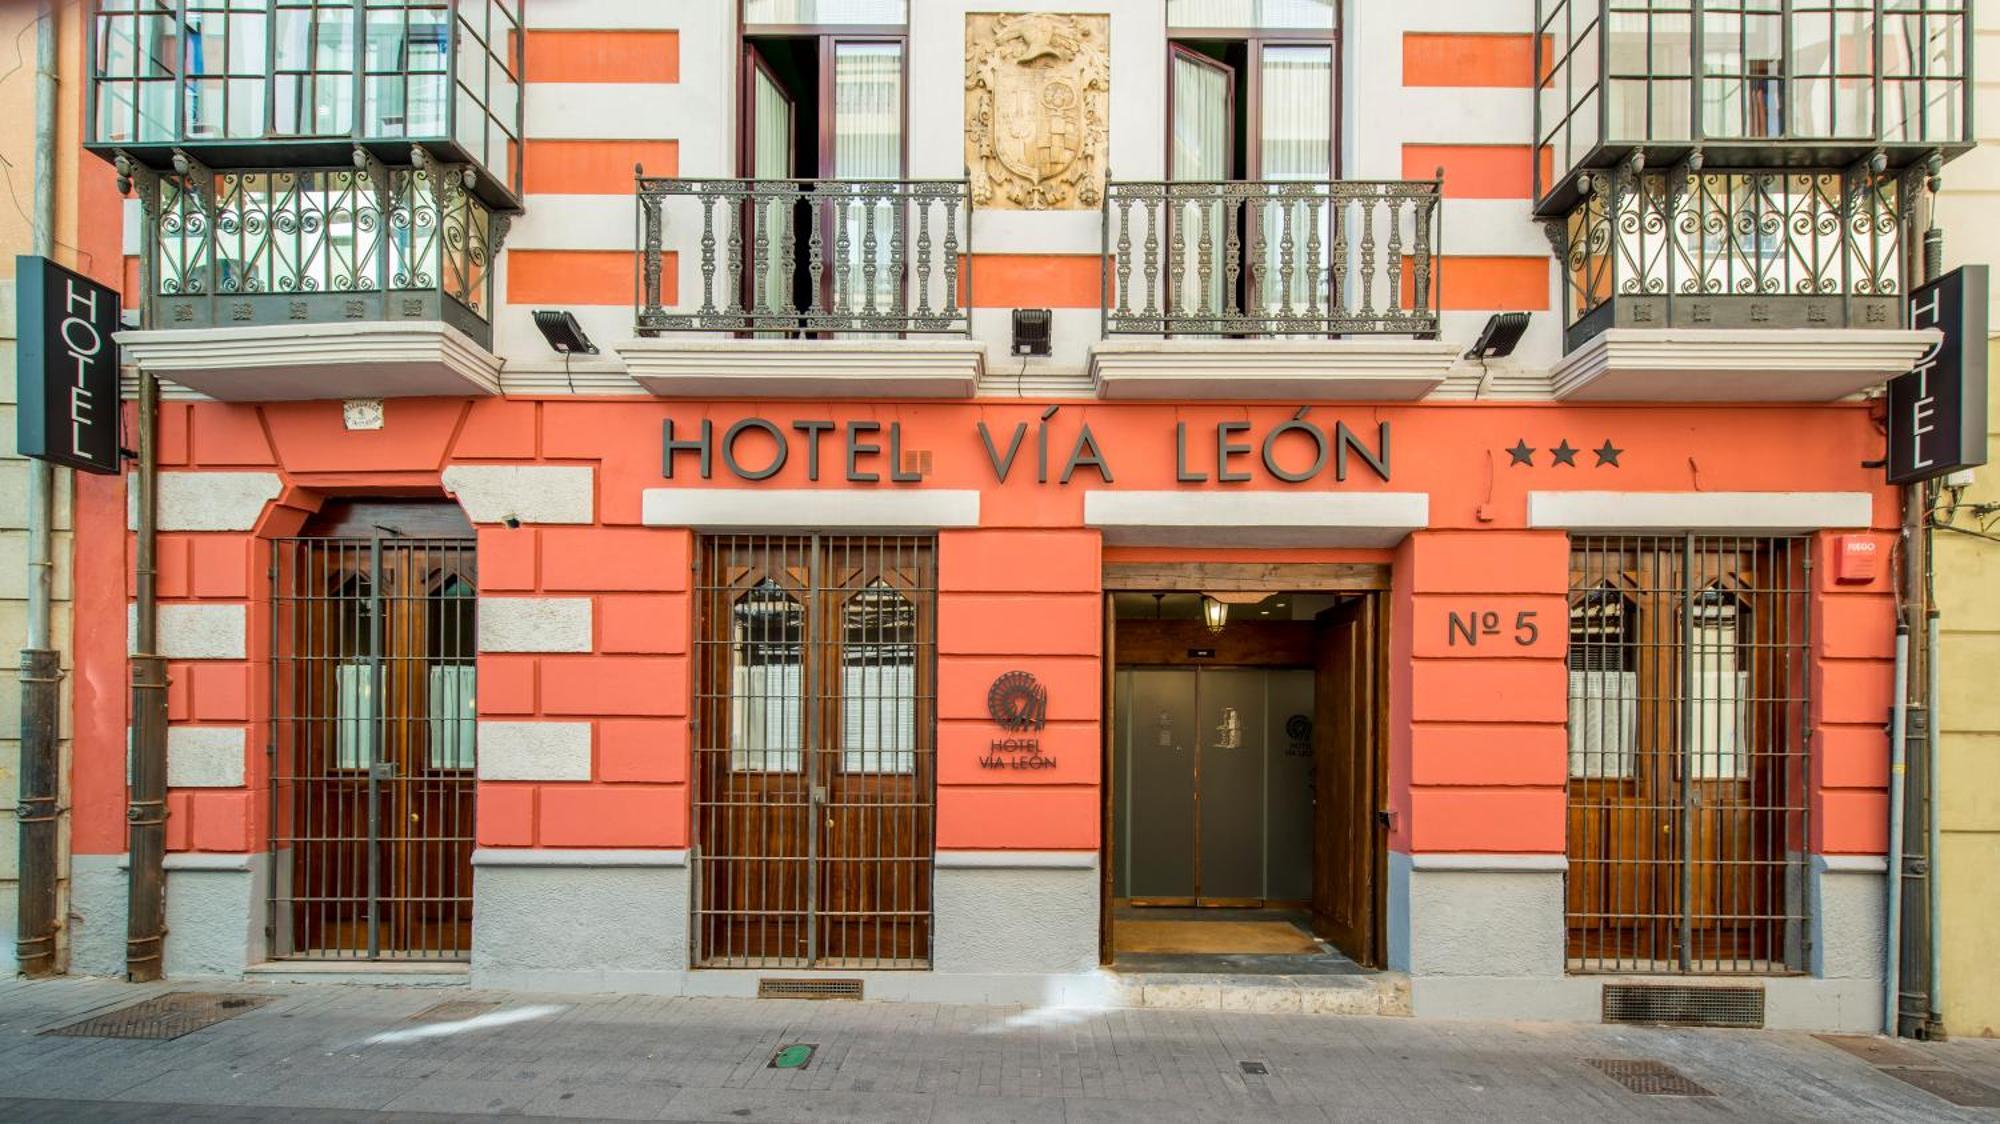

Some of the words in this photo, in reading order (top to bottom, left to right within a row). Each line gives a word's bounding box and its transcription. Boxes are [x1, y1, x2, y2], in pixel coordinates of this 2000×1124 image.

[61, 279, 101, 459] HOTEL
[662, 417, 922, 482] HOTEL
[976, 404, 1114, 484] VÍA
[1176, 405, 1390, 483] LEÓN
[1514, 611, 1539, 647] 5
[991, 739, 1043, 753] HOTEL
